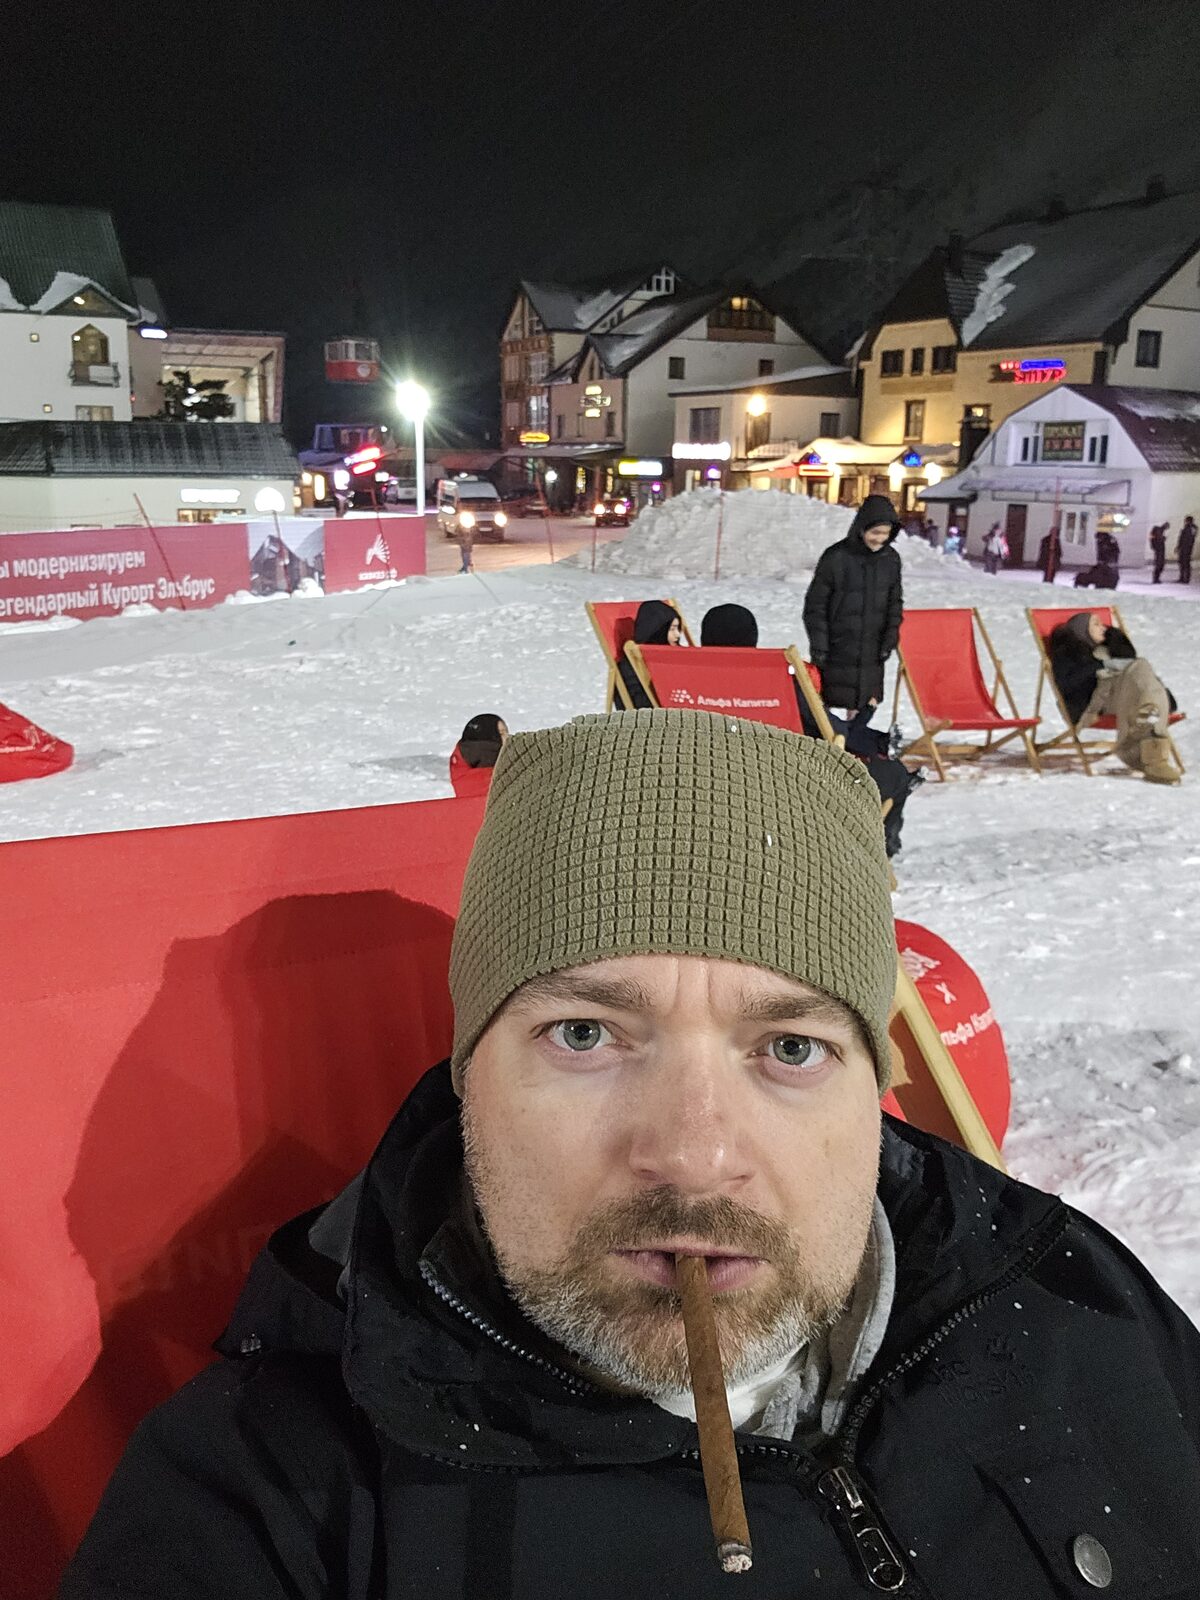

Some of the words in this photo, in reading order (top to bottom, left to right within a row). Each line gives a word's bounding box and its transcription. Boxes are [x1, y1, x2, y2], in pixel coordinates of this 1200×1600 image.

[0, 560, 10, 578] ы
[13, 550, 146, 580] модернизируем
[0, 582, 99, 617] егендарный
[102, 581, 156, 610] Курорт
[157, 574, 216, 601] Эльбрус
[697, 694, 731, 708] Альфа
[733, 697, 780, 708] Капитал
[940, 1021, 976, 1047] льфа
